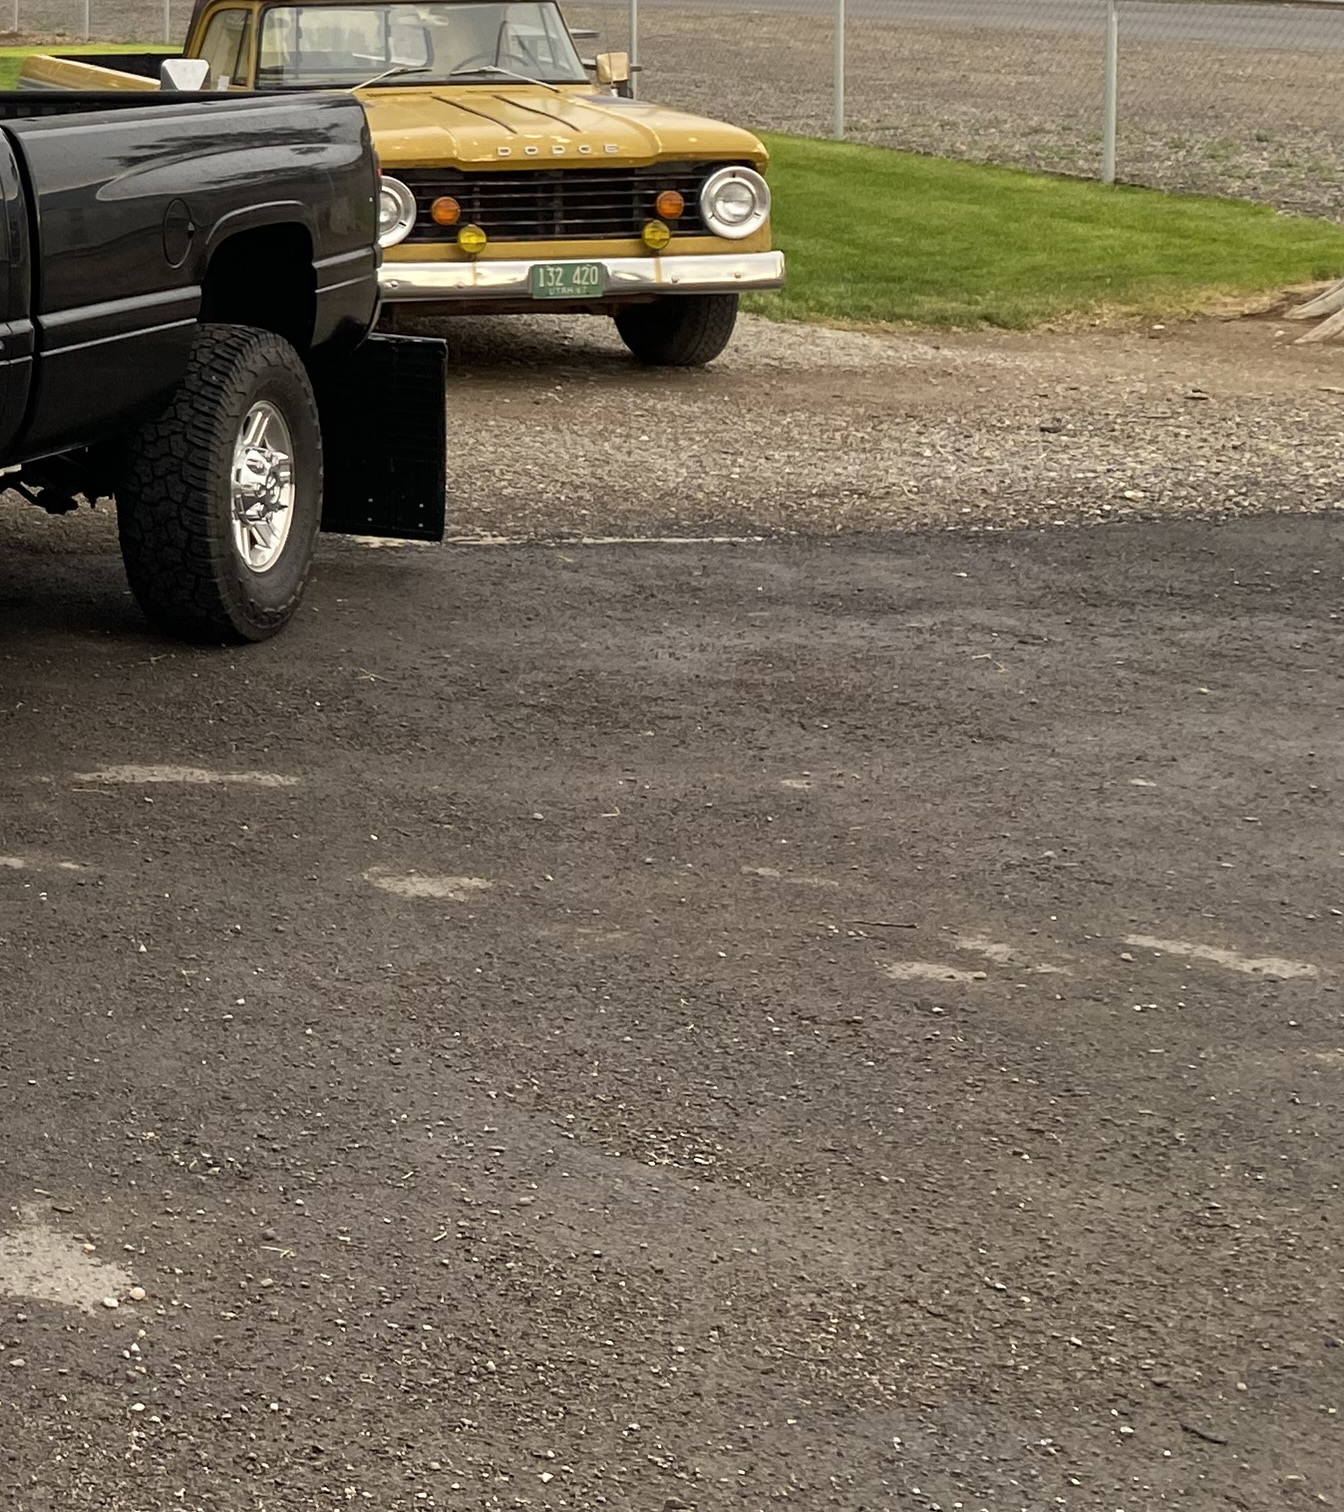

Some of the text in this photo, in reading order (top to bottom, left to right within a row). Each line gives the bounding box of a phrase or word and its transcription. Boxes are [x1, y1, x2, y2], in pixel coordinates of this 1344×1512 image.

[497, 143, 619, 157] DODGE
[538, 265, 599, 288] 132 420
